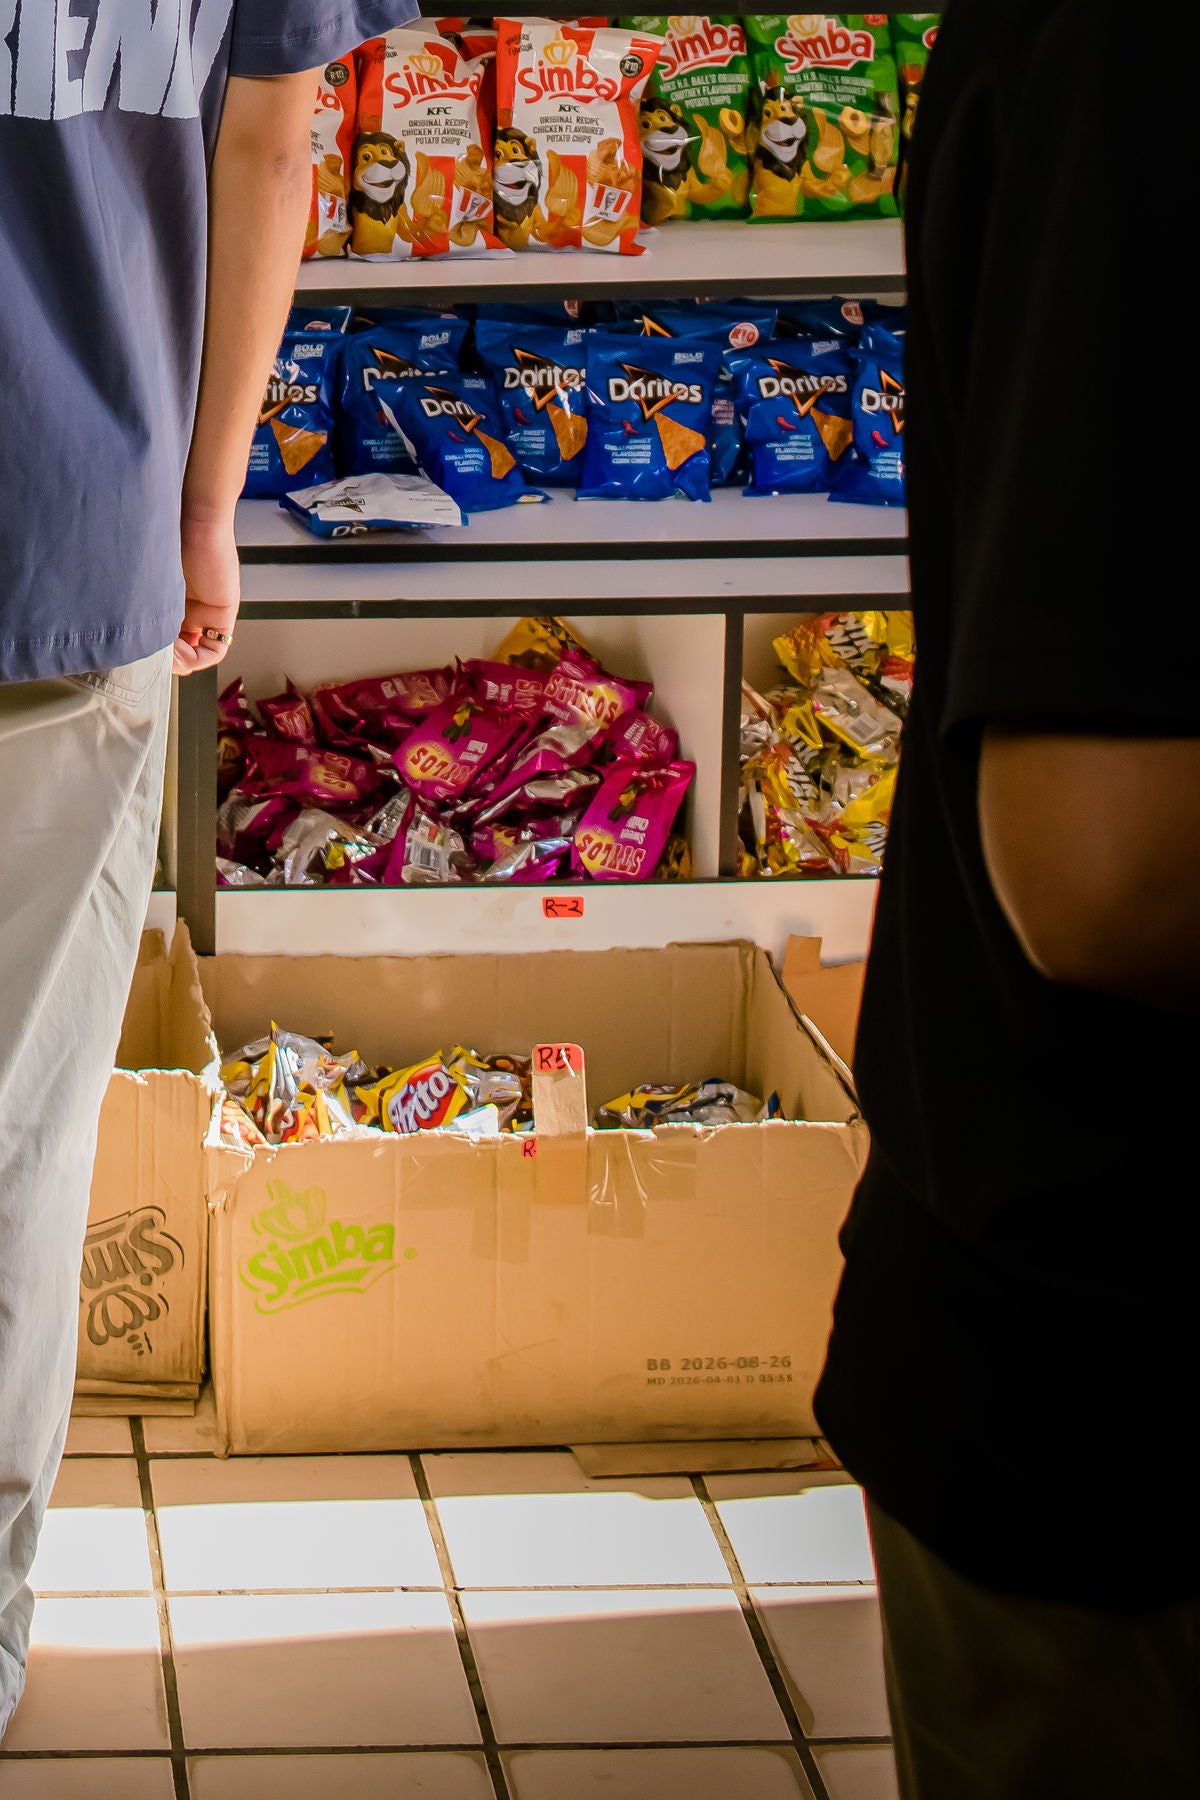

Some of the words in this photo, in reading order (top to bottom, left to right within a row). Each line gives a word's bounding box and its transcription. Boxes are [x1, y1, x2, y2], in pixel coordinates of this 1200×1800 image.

[775, 18, 873, 72] Simba
[517, 58, 620, 105] Simba
[426, 106, 453, 116] KFC
[558, 104, 581, 114] KFC
[608, 377, 703, 403] Doritos
[758, 374, 848, 398] Doritos
[576, 832, 646, 877] STYLOS
[545, 898, 581, 916] R-2
[536, 1046, 574, 1070] R5
[246, 1220, 397, 1302] Simba
[646, 1358, 672, 1371] BB
[680, 1355, 792, 1371] 2026-08-26
